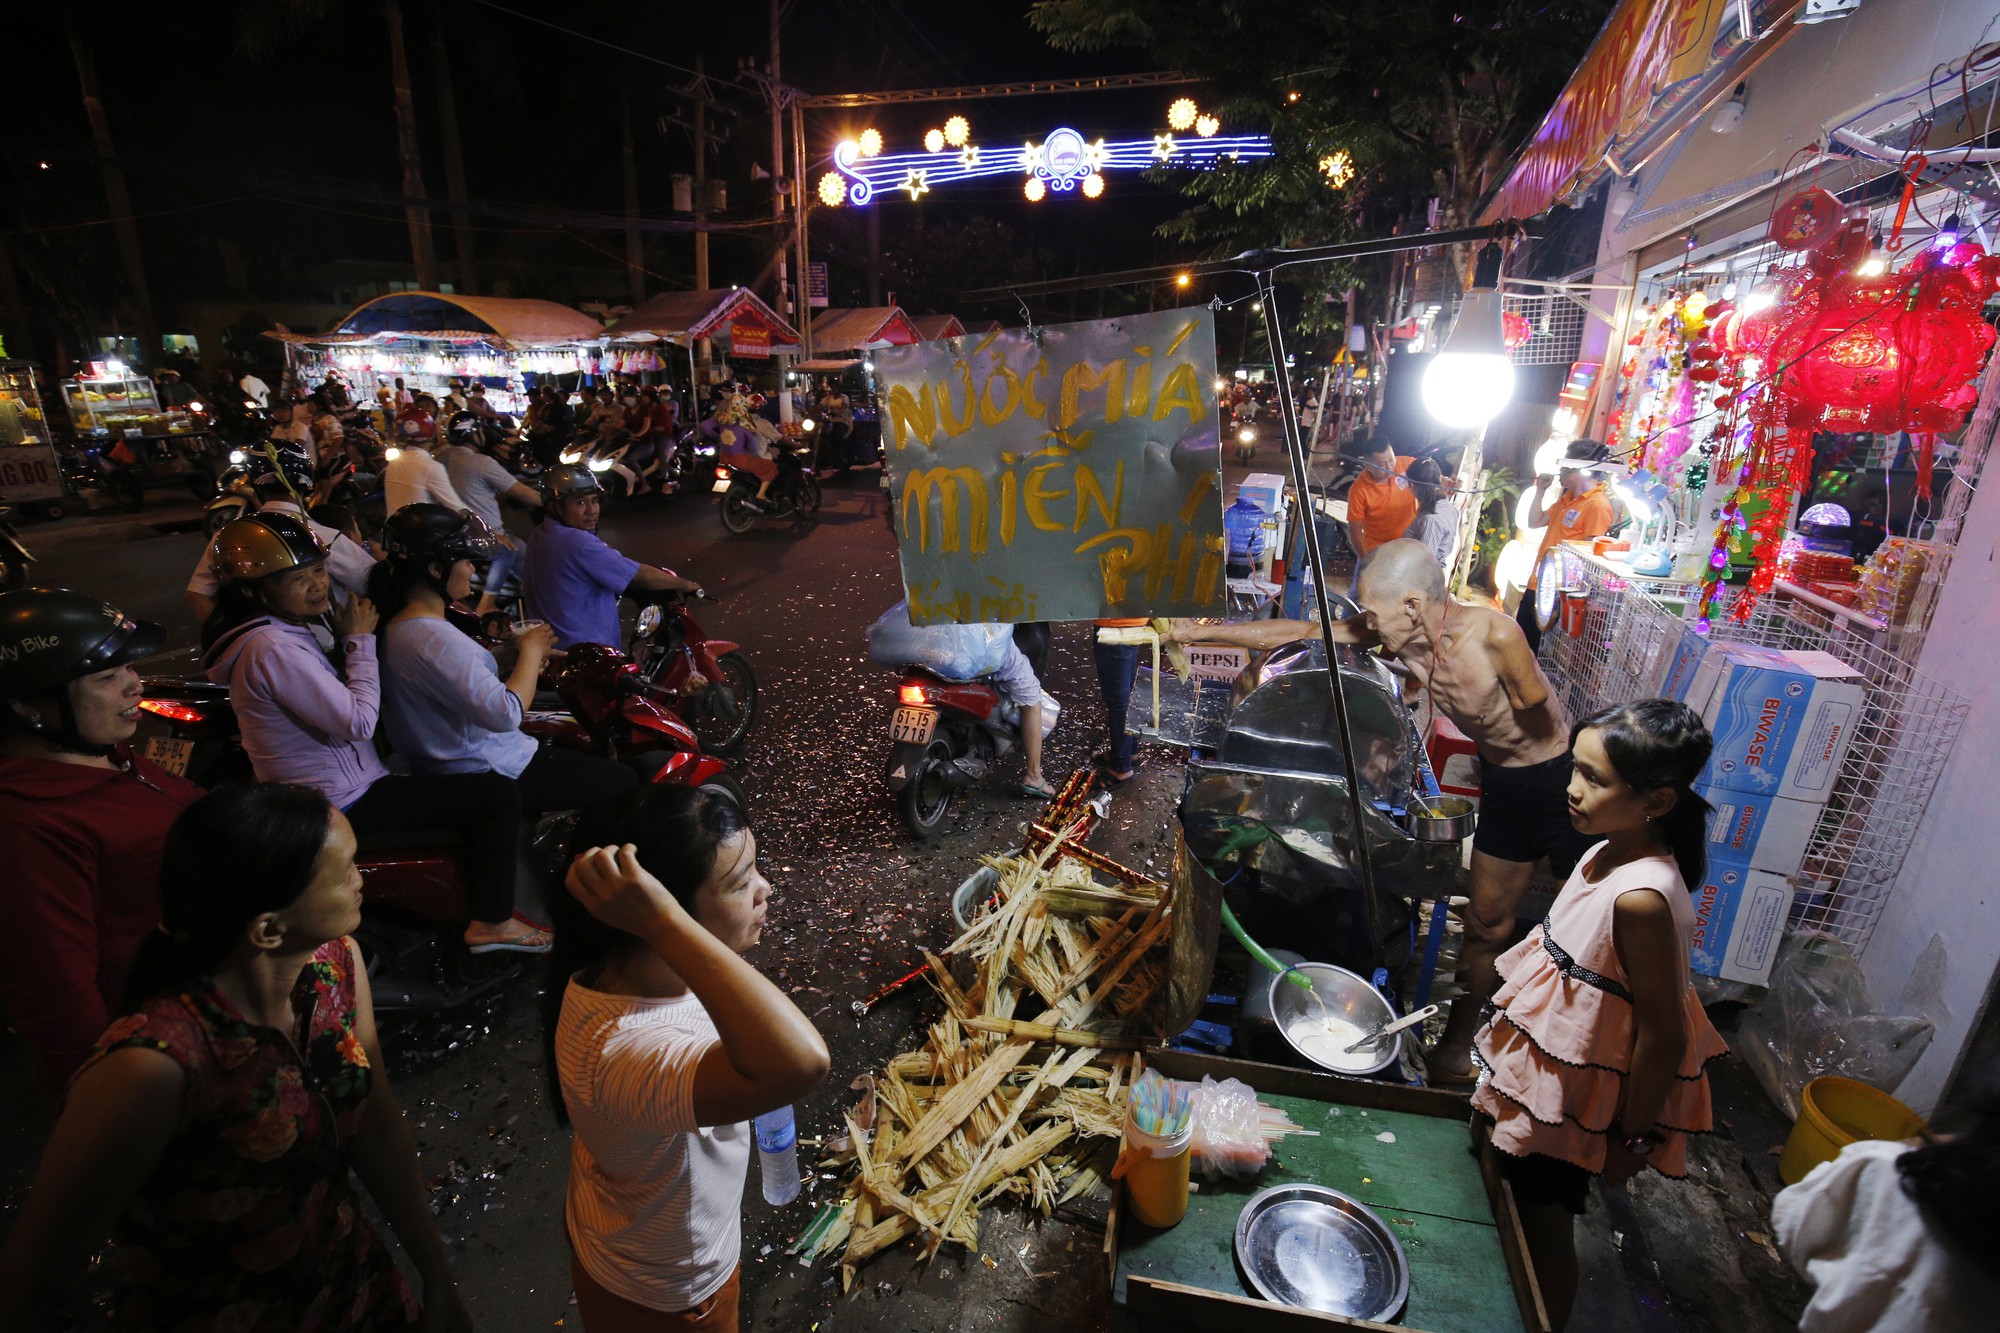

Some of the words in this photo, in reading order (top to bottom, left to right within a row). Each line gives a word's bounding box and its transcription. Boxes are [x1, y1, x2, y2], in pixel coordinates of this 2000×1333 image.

[21, 635, 60, 653] Bike
[1190, 652, 1240, 668] PEPSI
[897, 709, 931, 727] 61-T5
[893, 724, 926, 742] 6718
[1744, 698, 1782, 767] BIWASE
[1822, 725, 1841, 762] BIWASE
[1731, 805, 1755, 850] BIWASE
